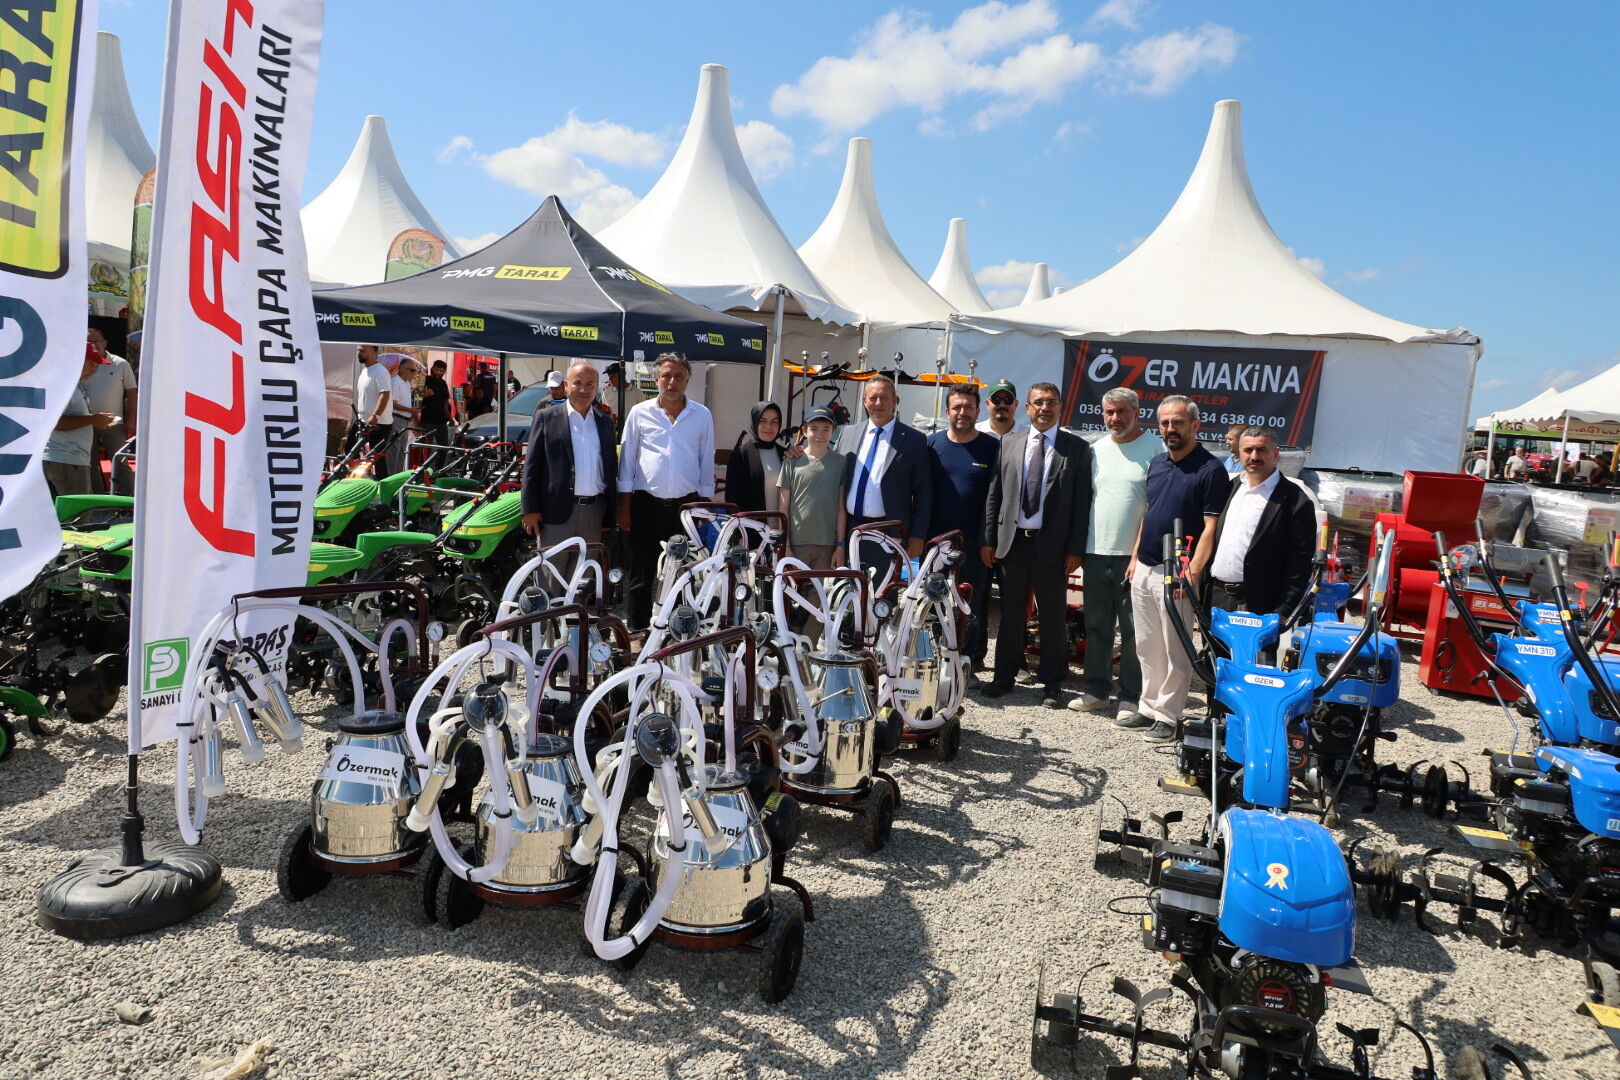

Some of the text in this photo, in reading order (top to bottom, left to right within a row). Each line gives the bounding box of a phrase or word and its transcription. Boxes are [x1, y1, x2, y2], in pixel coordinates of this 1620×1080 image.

[442, 266, 560, 279] PMG TARAL
[248, 23, 304, 556] MOTORLU ÇAPA MAKİNALARI
[315, 312, 373, 325] PMG TARAL
[420, 316, 482, 329] PMG TARAL
[530, 325, 596, 339] PMG TARAL
[1087, 348, 1180, 389] ÖZER
[1220, 413, 1245, 425] 638
[1248, 415, 1265, 426] 60
[1268, 416, 1286, 428] 00
[1519, 644, 1555, 656] YMN 310
[141, 692, 175, 710] SANAYİ
[336, 753, 399, 779] Özermak
